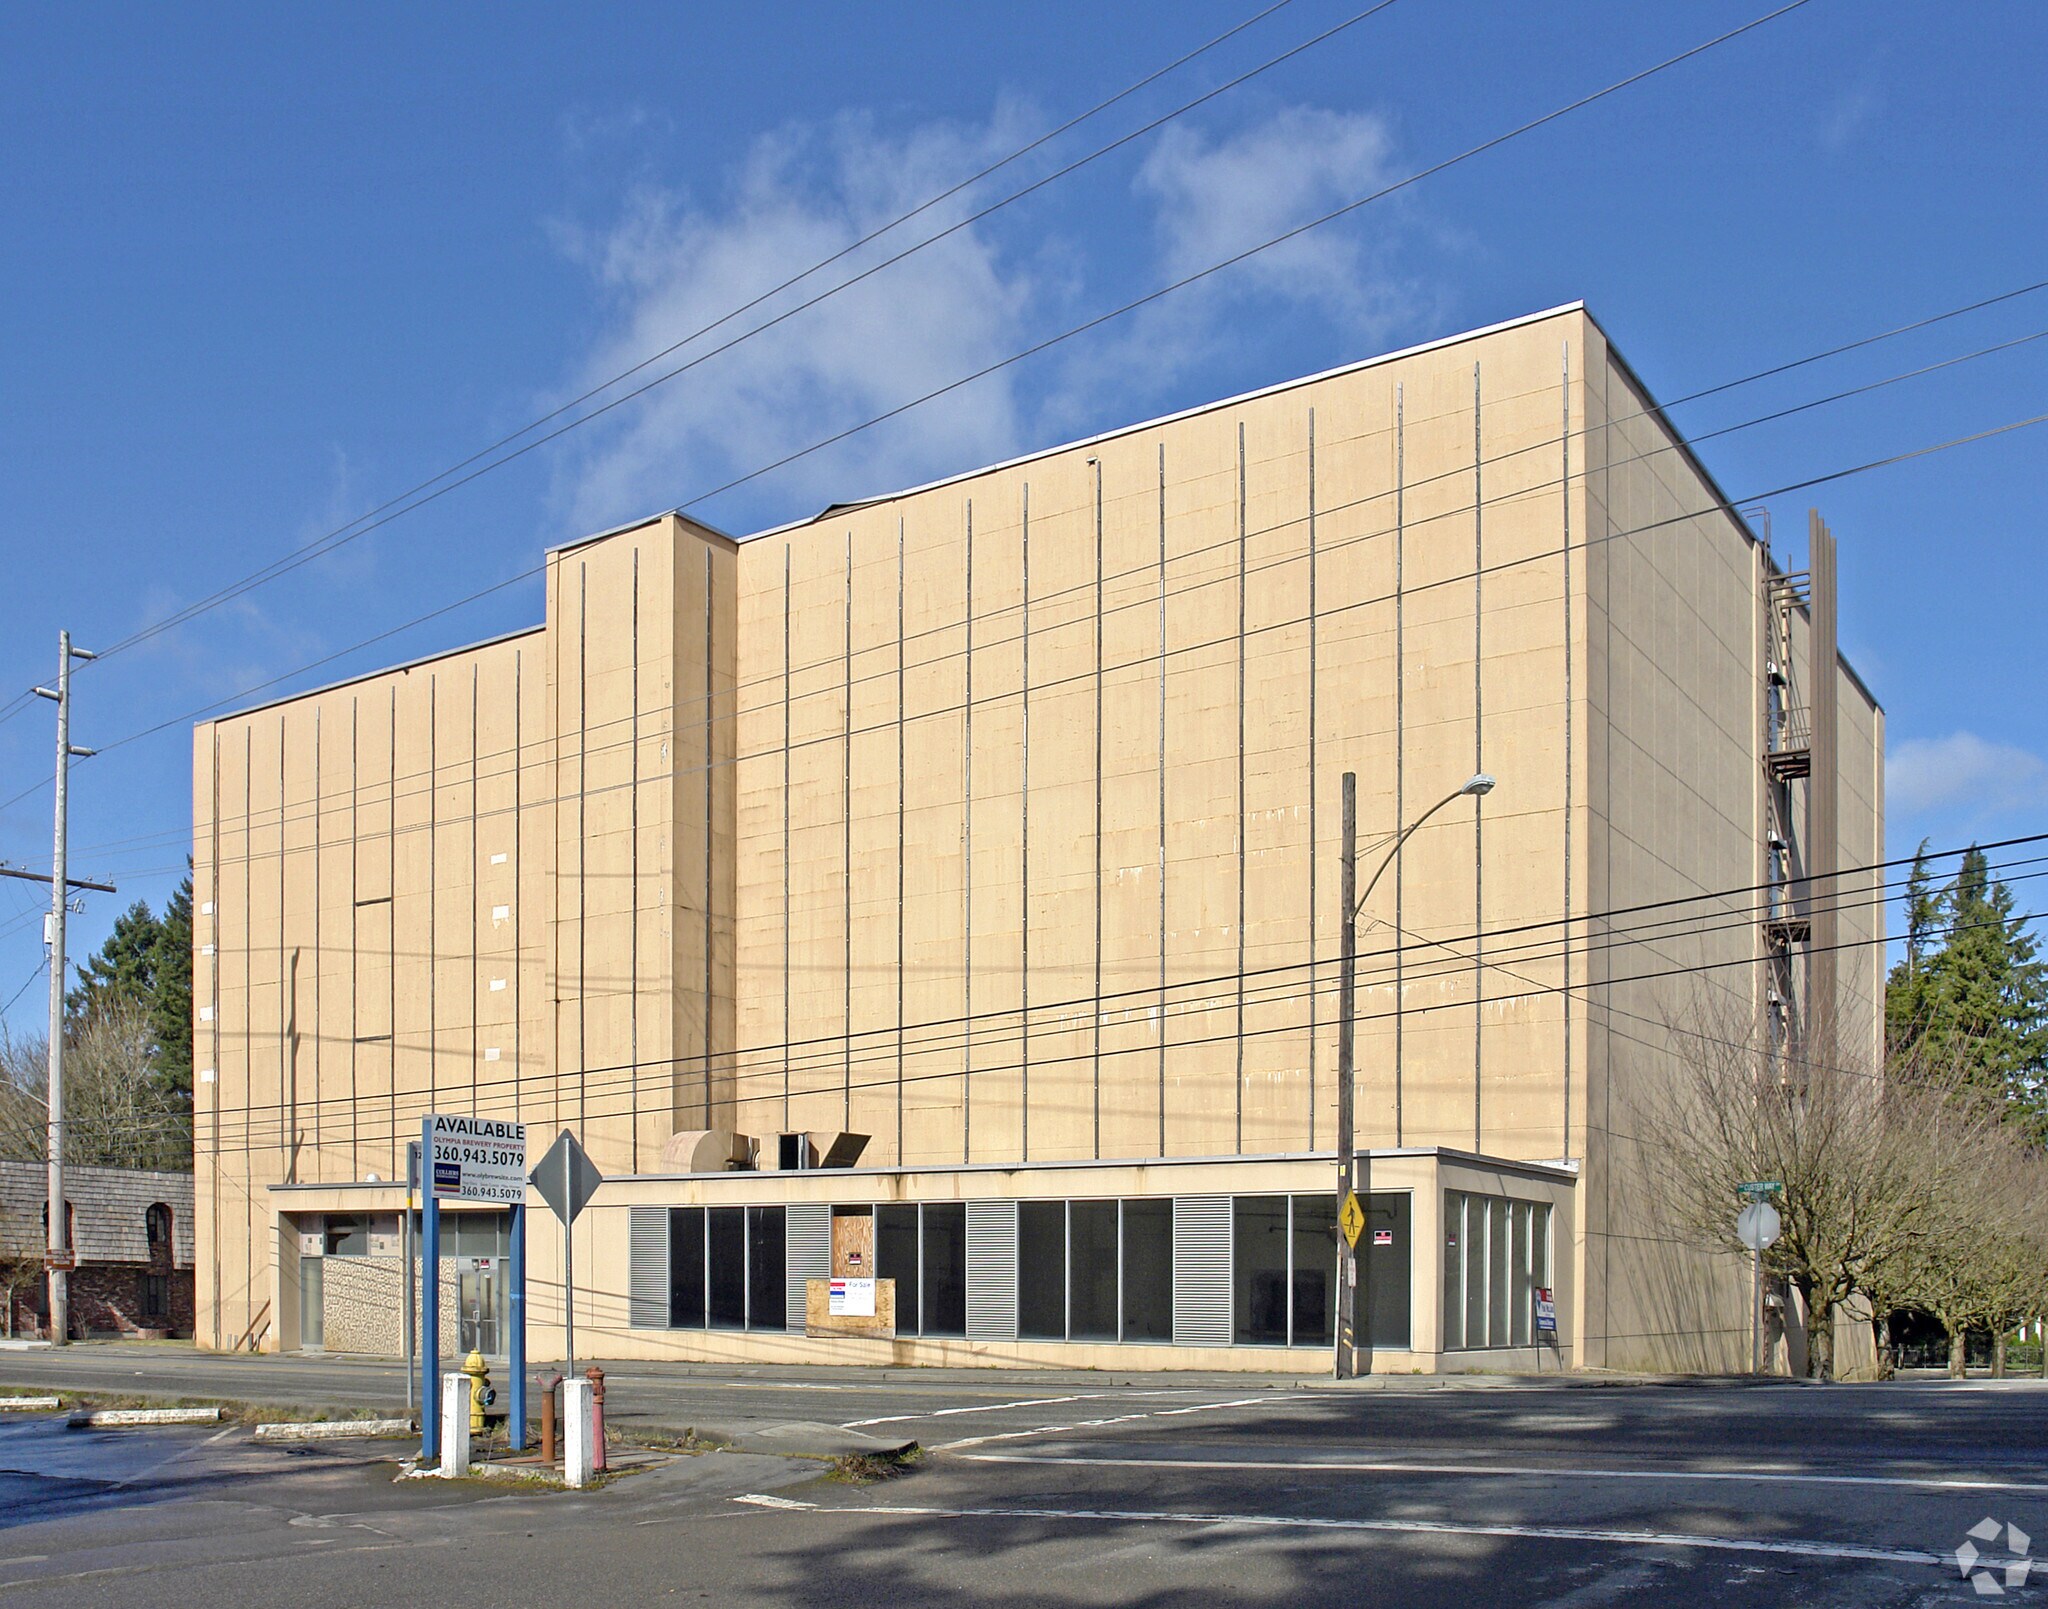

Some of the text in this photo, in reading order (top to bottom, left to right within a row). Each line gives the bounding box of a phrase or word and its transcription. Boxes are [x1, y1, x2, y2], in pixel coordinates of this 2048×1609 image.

[435, 1117, 525, 1140] AVAILABLE
[433, 1136, 525, 1151] OLYMPIA BREWERY PROPERTY
[434, 1145, 524, 1167] 360.943.5079
[462, 1186, 522, 1200] 360.943.5079
[1744, 1183, 1764, 1192] CUSTER
[1764, 1182, 1775, 1190] WAY
